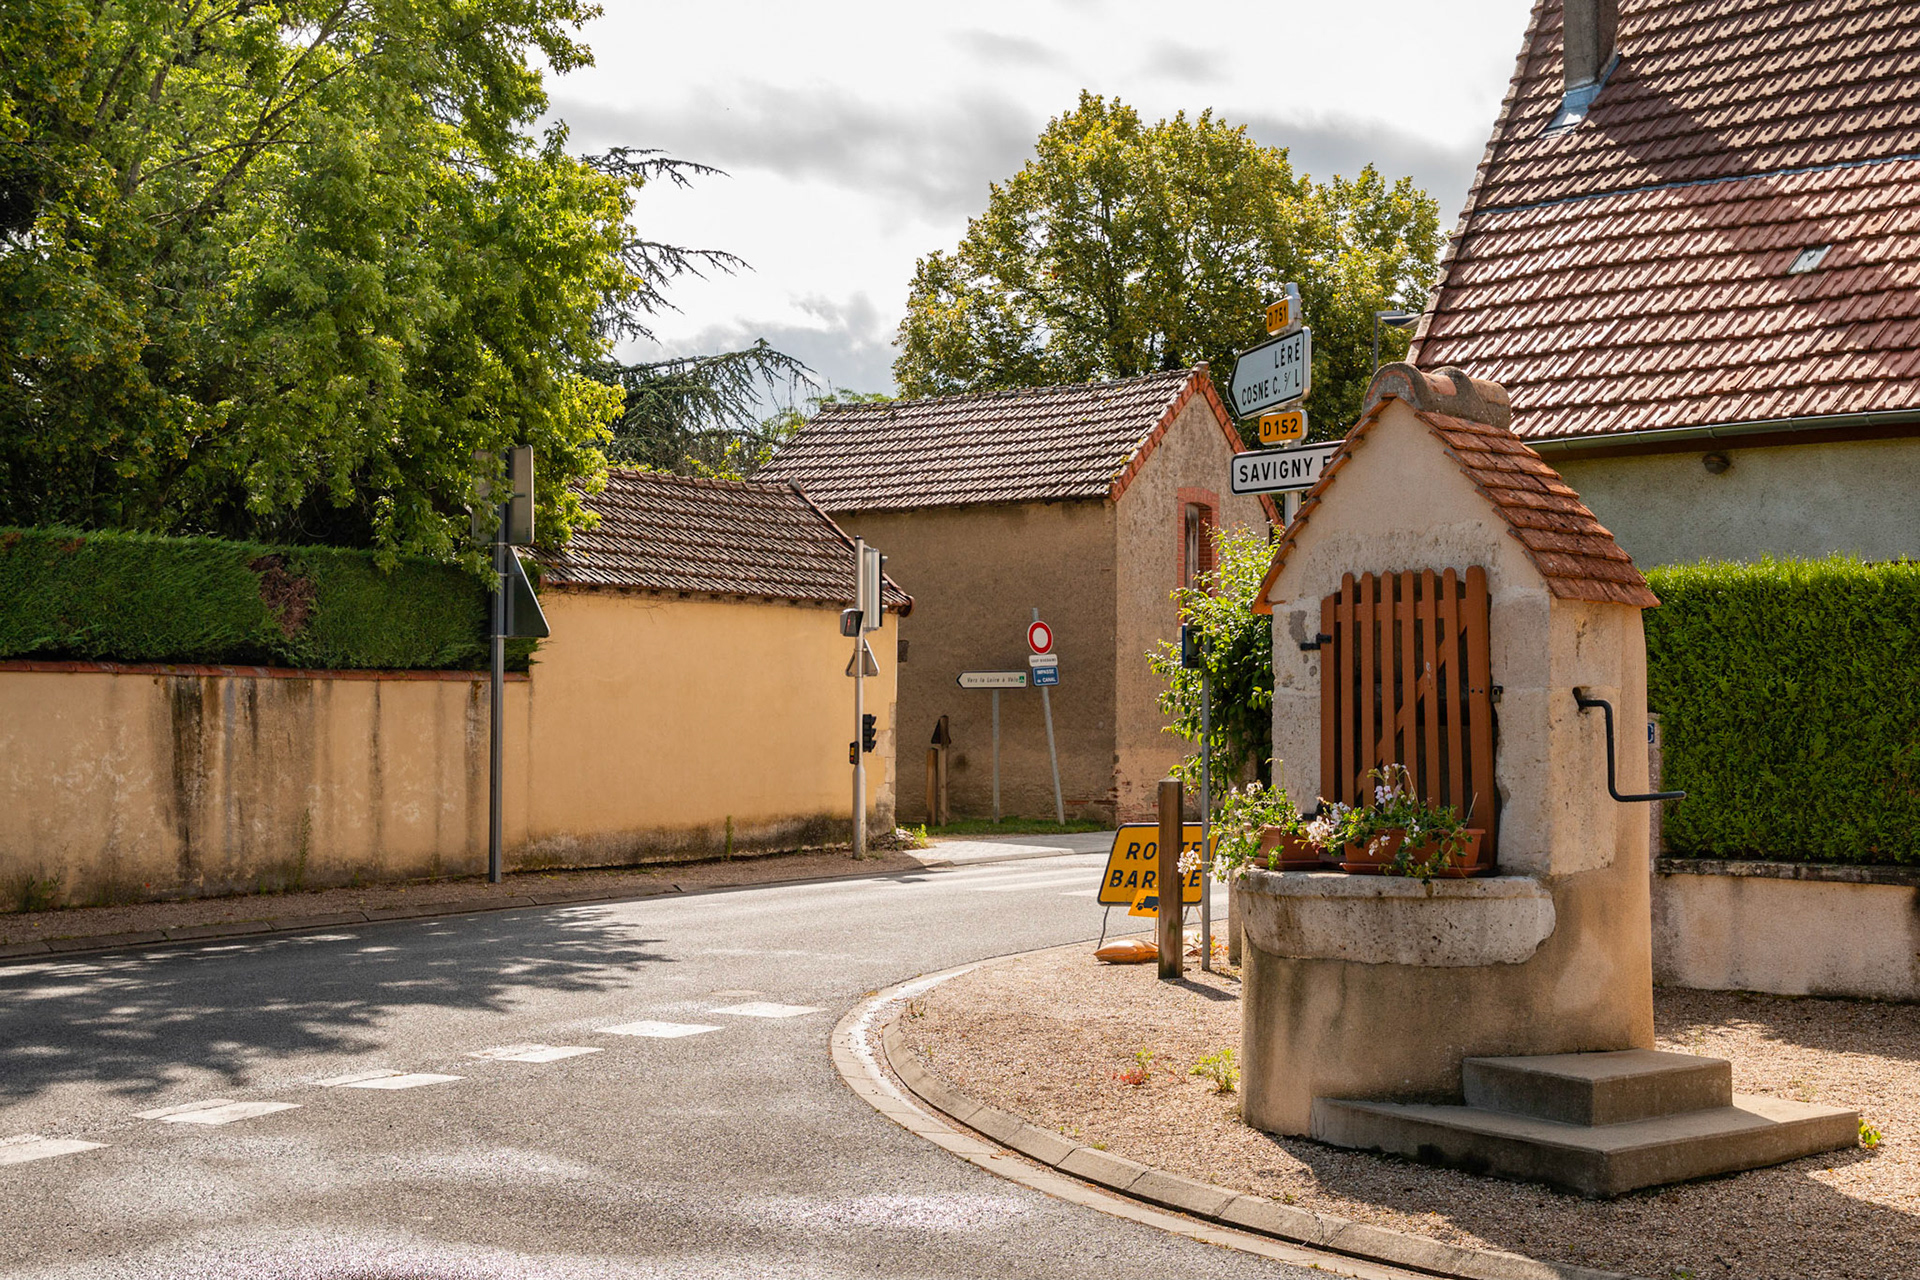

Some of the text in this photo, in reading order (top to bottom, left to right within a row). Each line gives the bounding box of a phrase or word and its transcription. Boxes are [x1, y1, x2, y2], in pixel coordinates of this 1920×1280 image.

[1274, 337, 1300, 369] LÉRÉ
[1241, 379, 1269, 406] COSNE
[1239, 457, 1313, 483] SAVIGNY
[1125, 841, 1203, 860] ROE
[1109, 869, 1203, 888] BARE
